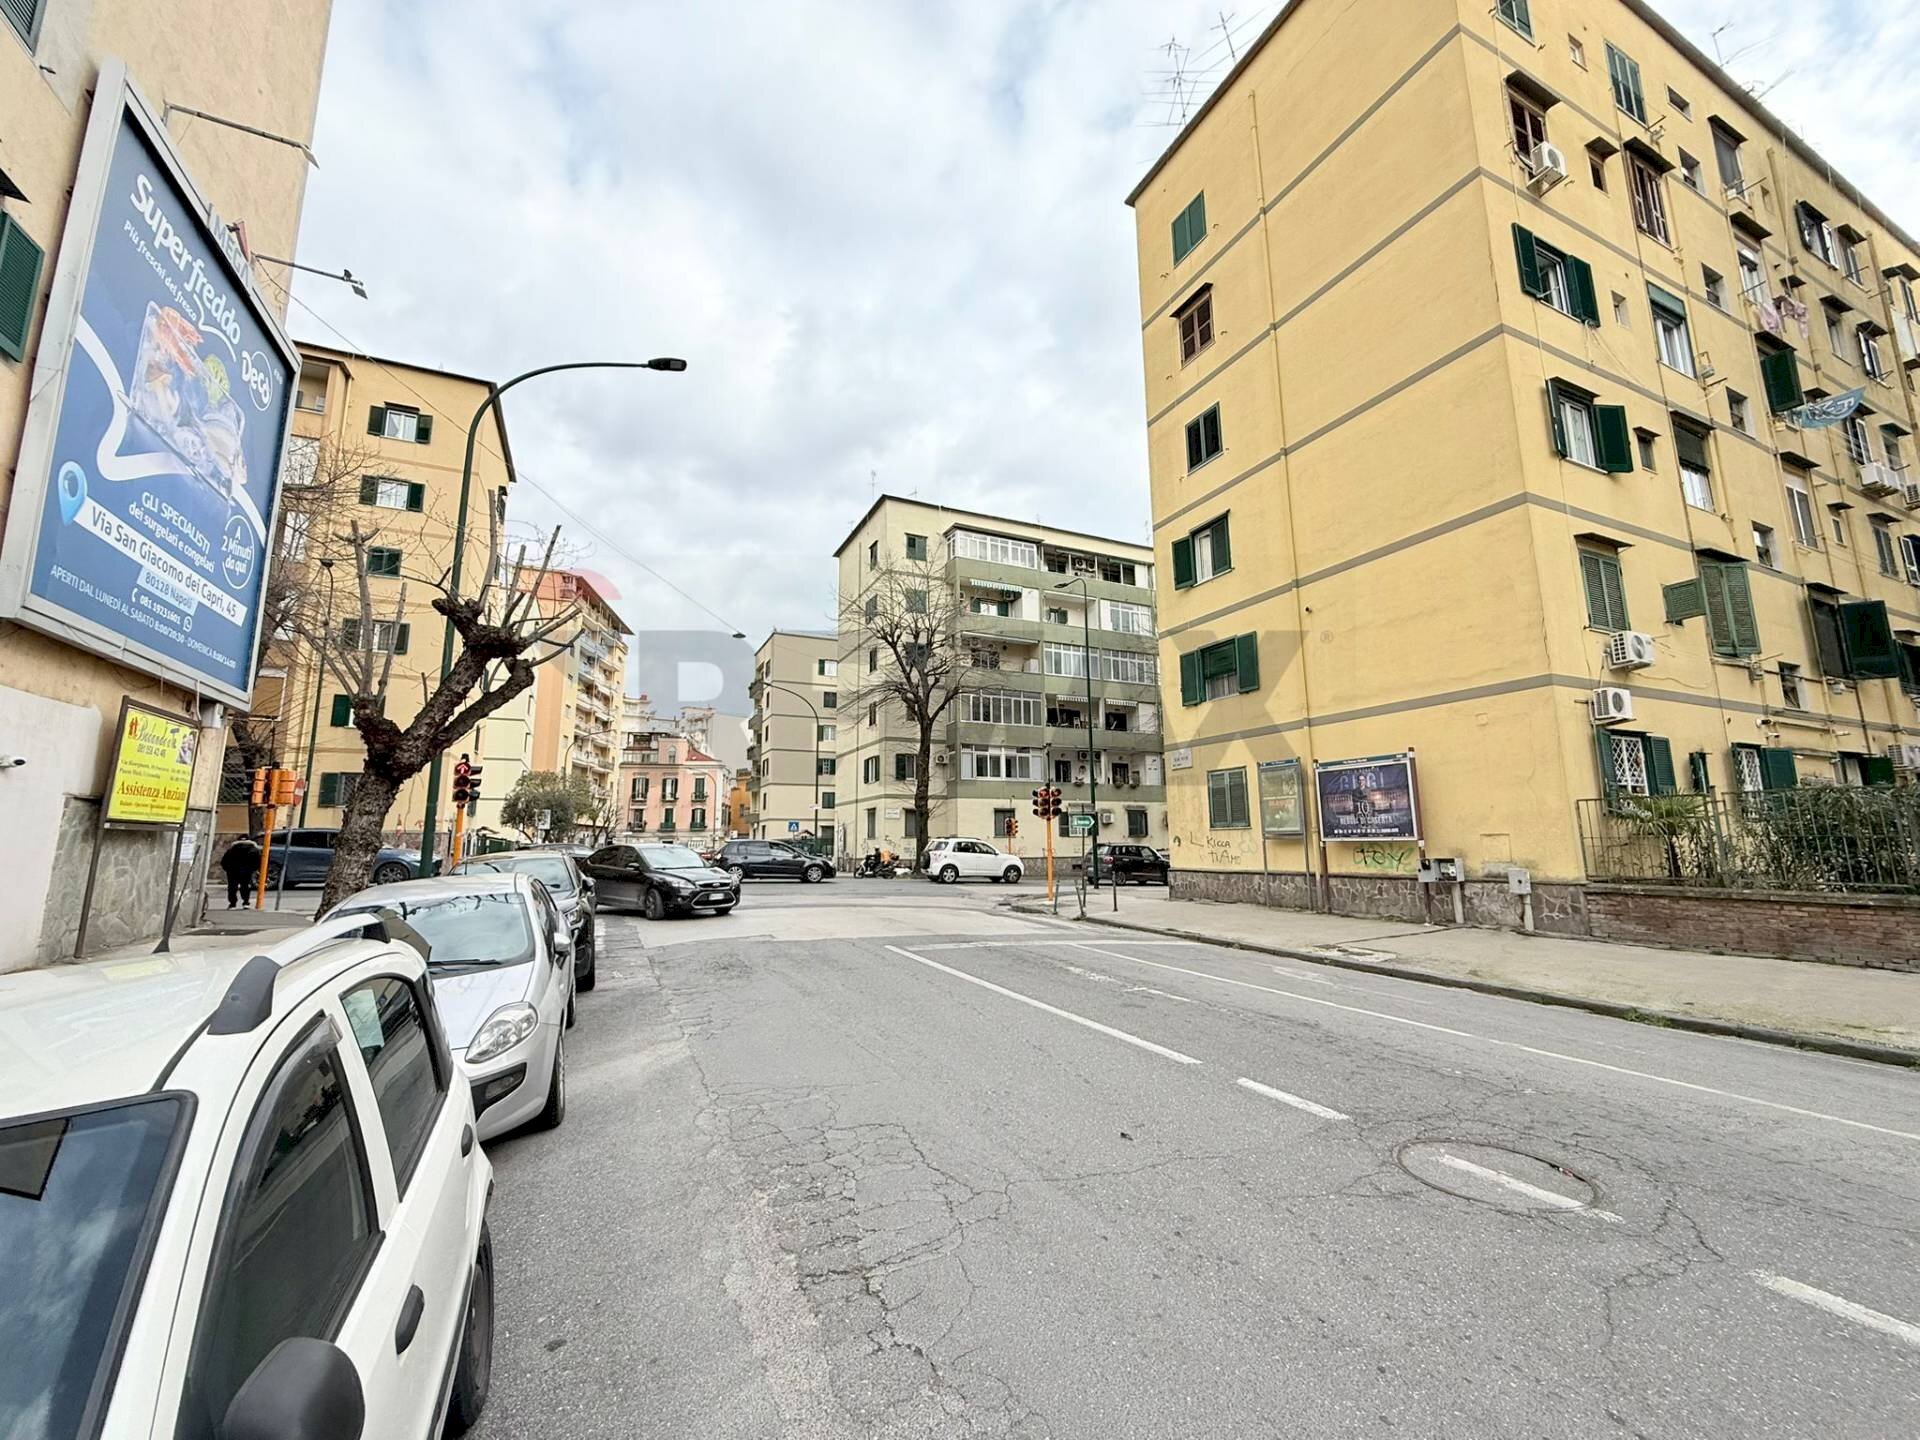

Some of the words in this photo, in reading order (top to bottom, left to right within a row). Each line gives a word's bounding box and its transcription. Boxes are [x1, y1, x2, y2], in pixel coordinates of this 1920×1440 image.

[174, 291, 197, 321] fresco
[129, 502, 143, 521] dei
[143, 514, 178, 547] surgelati
[178, 540, 184, 551] e
[184, 544, 215, 573] congelati
[142, 492, 158, 512] GLI
[161, 502, 210, 554] SPECIALISTI
[234, 525, 241, 540] A
[221, 535, 229, 551] 2
[92, 506, 112, 536] Via
[115, 524, 137, 552] San
[139, 541, 183, 583] Giacomo
[185, 574, 200, 594] dei
[201, 583, 224, 612] Capri,
[226, 603, 236, 618] 45
[50, 564, 79, 589] APERTI
[79, 580, 94, 598] DAL
[120, 603, 130, 616] AL
[130, 607, 154, 628] SABATO
[145, 572, 170, 595] 80128
[117, 781, 160, 799] Assistenza
